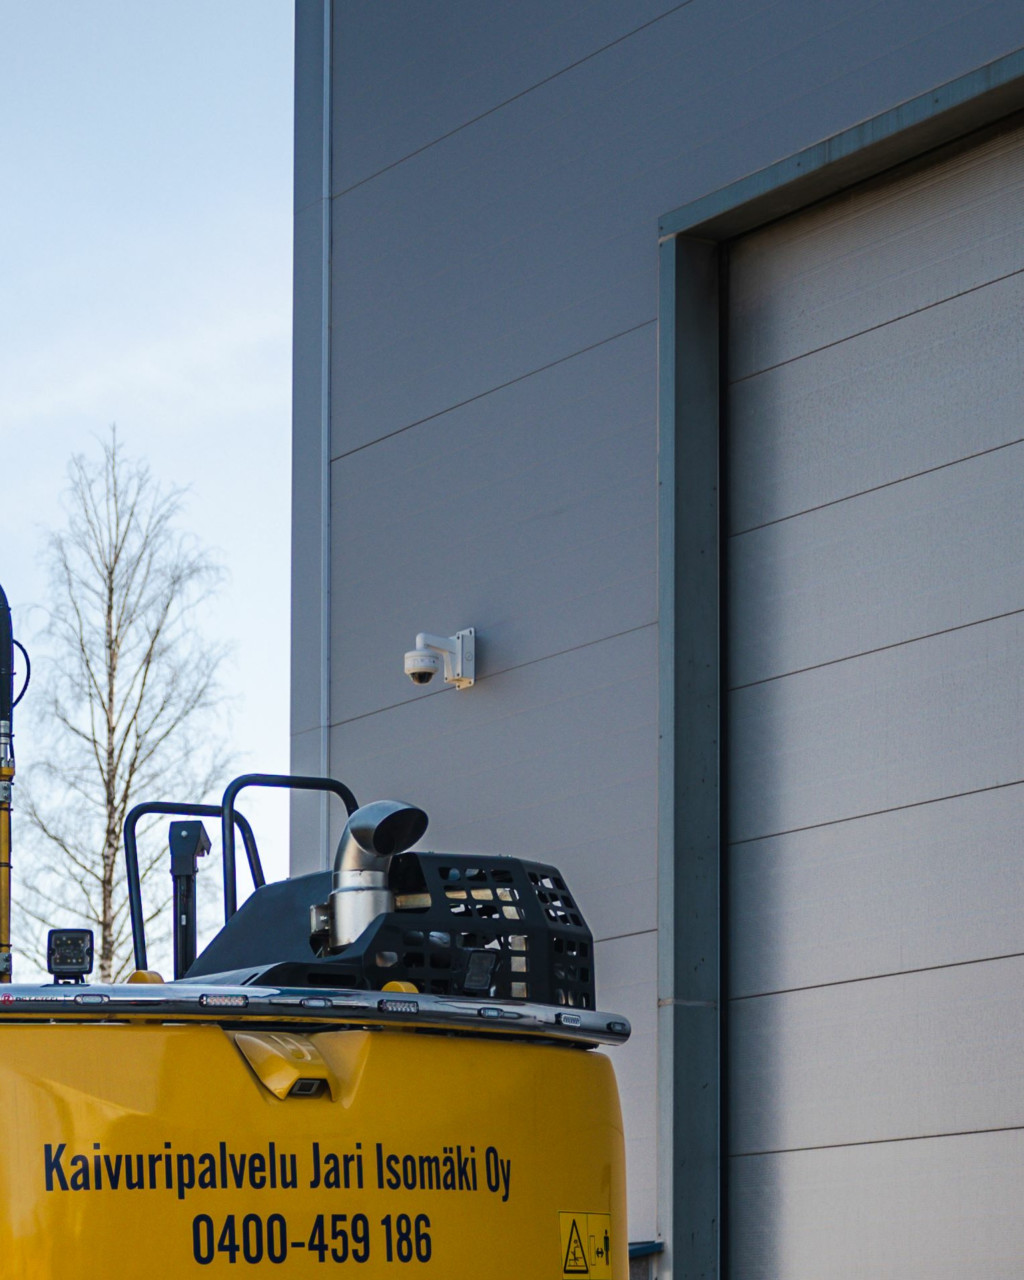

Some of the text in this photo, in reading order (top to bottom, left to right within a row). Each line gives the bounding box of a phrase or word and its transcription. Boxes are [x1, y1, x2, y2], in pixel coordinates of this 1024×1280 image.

[44, 1142, 511, 1202] Kaivuripalvelu Jari Isomäki Oy
[192, 1213, 432, 1265] 0400-459 186
